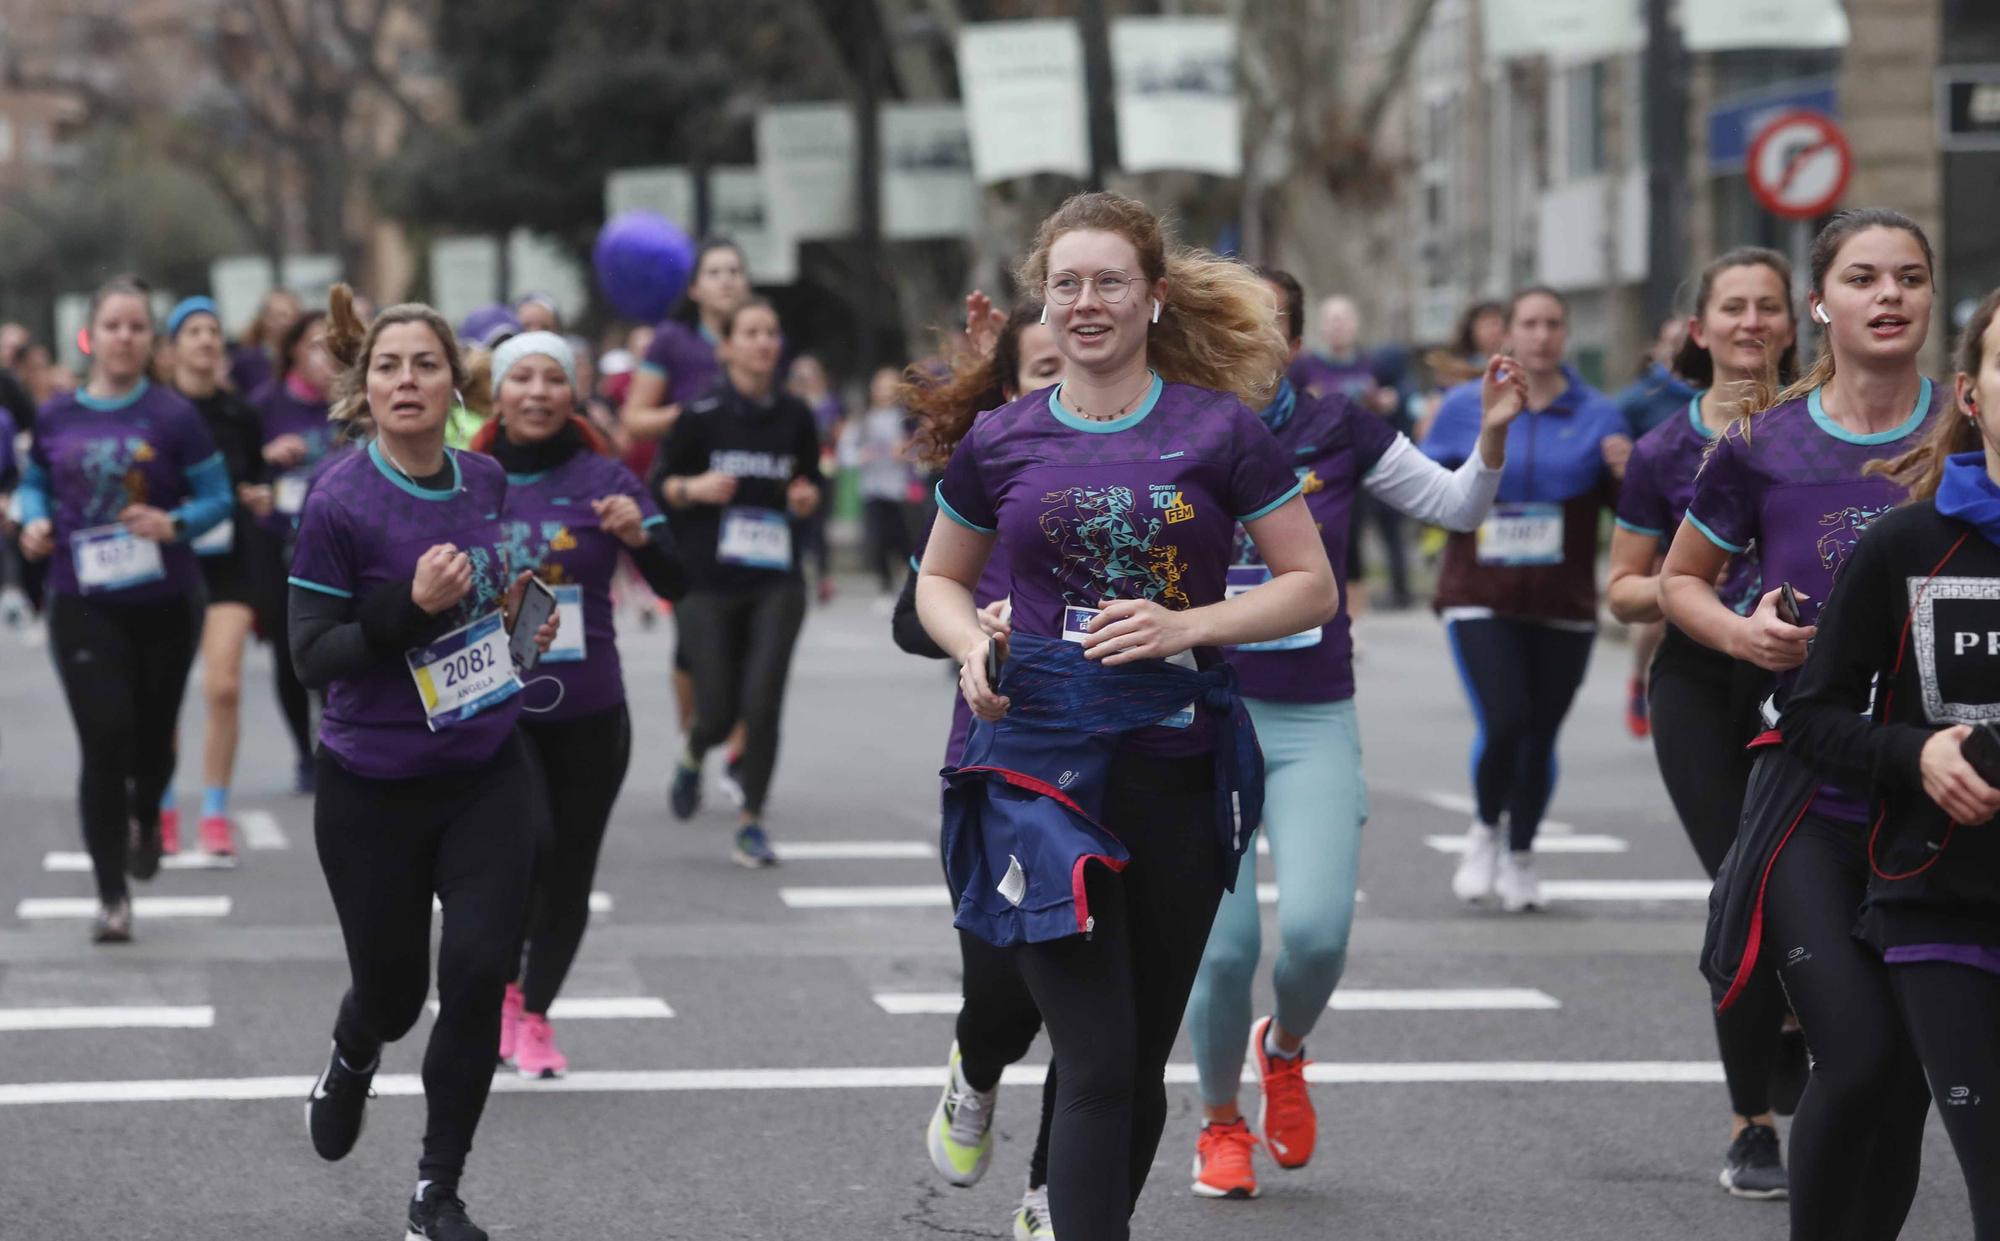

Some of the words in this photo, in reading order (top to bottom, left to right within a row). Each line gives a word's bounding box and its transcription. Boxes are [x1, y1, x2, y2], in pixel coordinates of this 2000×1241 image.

[1149, 491, 1184, 509] 10K
[1167, 507, 1193, 522] FEM
[442, 642, 495, 688] 2082
[457, 677, 494, 699] ANGELA
